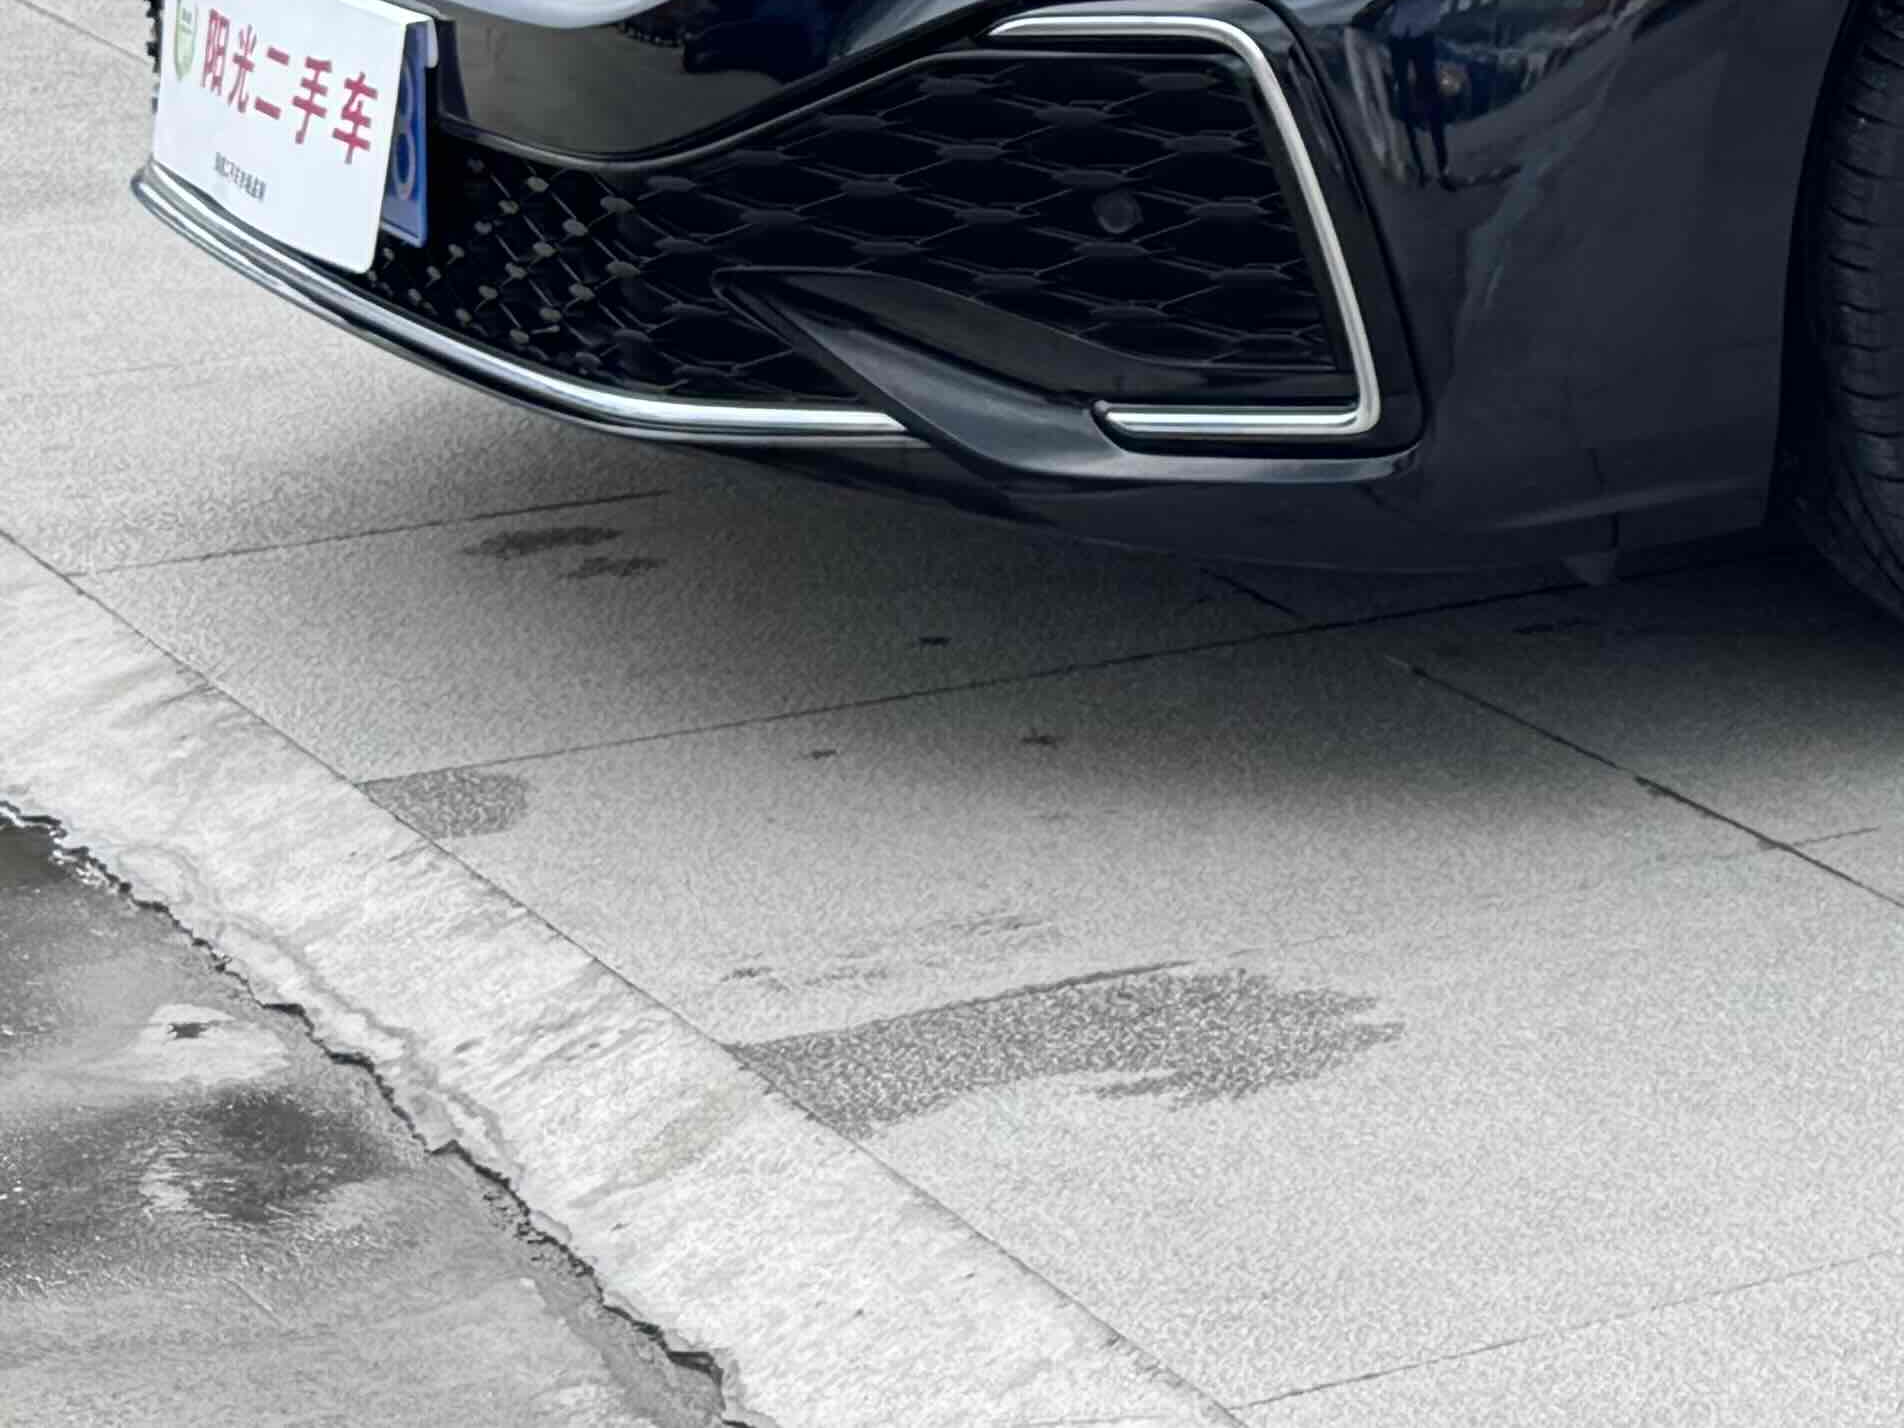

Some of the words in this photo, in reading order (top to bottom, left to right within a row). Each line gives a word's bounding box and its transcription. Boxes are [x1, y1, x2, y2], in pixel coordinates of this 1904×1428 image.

[199, 8, 379, 165] 阳光二手车
